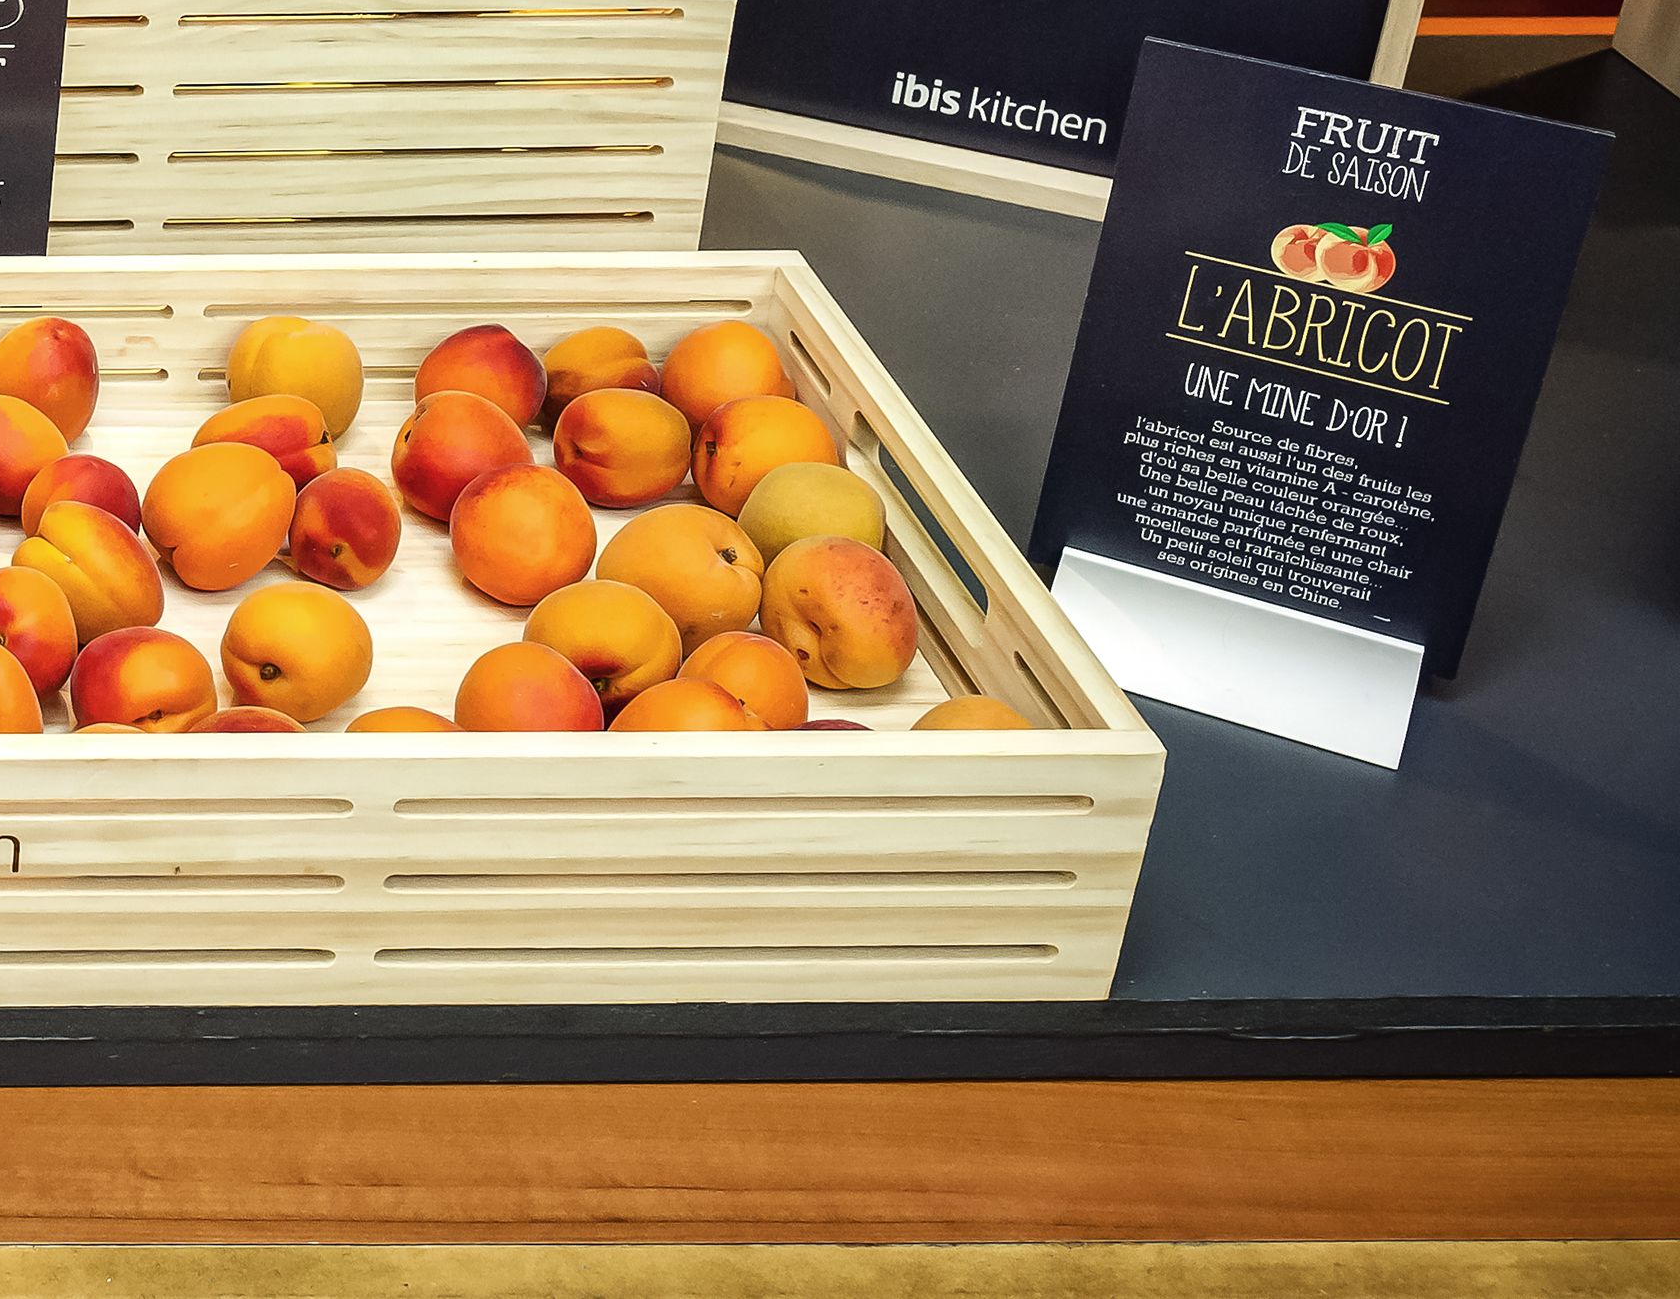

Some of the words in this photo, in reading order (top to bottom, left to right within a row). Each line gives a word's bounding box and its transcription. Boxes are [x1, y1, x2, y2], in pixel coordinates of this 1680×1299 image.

[890, 71, 961, 117] ibis
[967, 83, 1108, 145] kitchen
[1290, 106, 1440, 165] FRUIT
[1281, 141, 1321, 180] DE
[1327, 151, 1431, 203] SAISON
[1176, 264, 1463, 390] L'ABRICOT
[1183, 362, 1239, 406] UNE
[1243, 377, 1320, 426] MINE
[1325, 397, 1388, 444] D'OR
[1123, 431, 1159, 449] plus
[1163, 440, 1216, 463] riches
[1220, 457, 1241, 470] en
[1246, 462, 1319, 490] vitamine
[1321, 481, 1337, 495] A
[1352, 491, 1435, 522] carotène,
[1136, 416, 1205, 445] l'abricot
[1209, 438, 1234, 453] est
[1238, 445, 1282, 464] aussi
[1286, 455, 1317, 474] l'un
[1322, 465, 1354, 483] des
[1358, 473, 1402, 495] fruits
[1406, 486, 1432, 503] les
[1211, 420, 1272, 446] Source
[1277, 437, 1300, 452] de
[1304, 443, 1358, 469] fibres,
[1139, 464, 1172, 483] Une
[1175, 474, 1218, 496] belle
[1221, 489, 1265, 508] peau
[1270, 500, 1328, 525] tâchée
[1332, 517, 1355, 532] de
[1358, 525, 1404, 547] roux,
[1140, 451, 1177, 470] d'où
[1181, 463, 1200, 476] sa
[1205, 466, 1248, 487] belle
[1252, 481, 1319, 506] couleur
[1321, 500, 1409, 531] orangée...
[1173, 492, 1224, 513] noyau
[1228, 506, 1287, 528] unique
[1290, 522, 1387, 557] renfermant
[1117, 492, 1147, 509] une
[1151, 502, 1219, 528] amande
[1221, 521, 1306, 551] parfumée
[1309, 544, 1327, 557] et
[1331, 550, 1363, 566] une
[1367, 560, 1413, 580] chair
[1134, 513, 1221, 544] moelleuse
[1224, 537, 1240, 550] et
[1140, 527, 1162, 544] Un
[1165, 536, 1204, 555] petit
[1207, 547, 1252, 569] soleil
[1255, 561, 1284, 578] qui
[1288, 569, 1372, 602] trouverait
[1156, 551, 1186, 566] ses
[1189, 560, 1259, 587] origines
[1262, 579, 1284, 594] en
